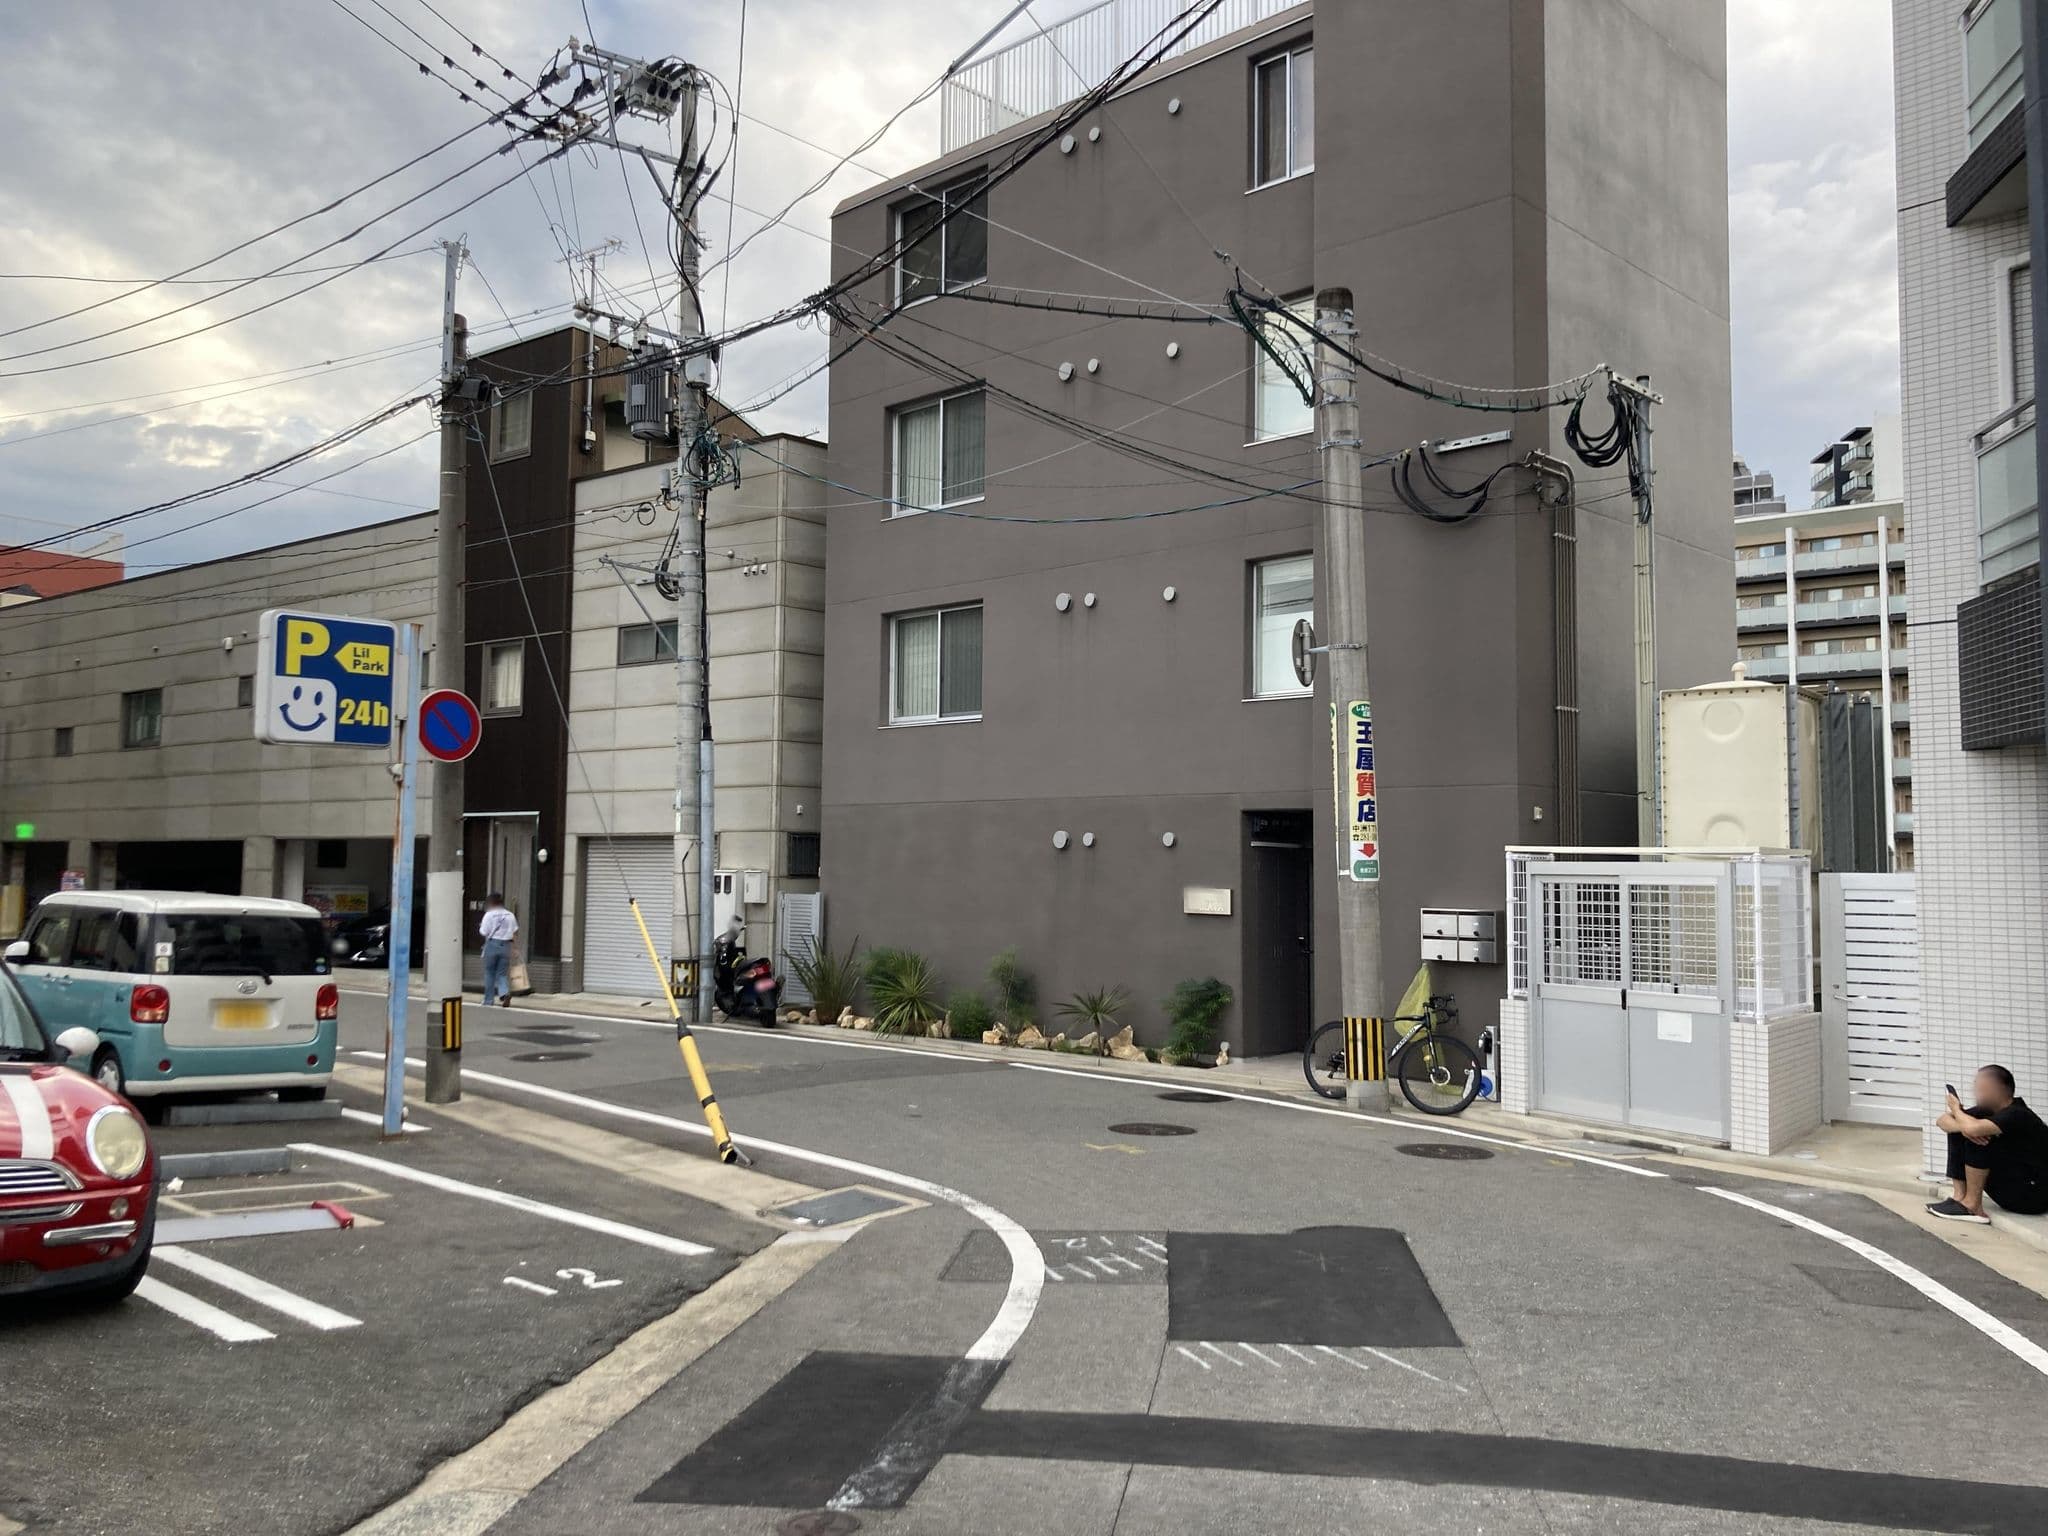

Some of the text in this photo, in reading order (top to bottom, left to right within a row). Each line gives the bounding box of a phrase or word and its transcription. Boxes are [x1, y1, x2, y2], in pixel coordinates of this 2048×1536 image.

[285, 619, 331, 676] P
[353, 647, 370, 658] Lil
[353, 659, 384, 672] Park
[339, 699, 389, 727] 24h
